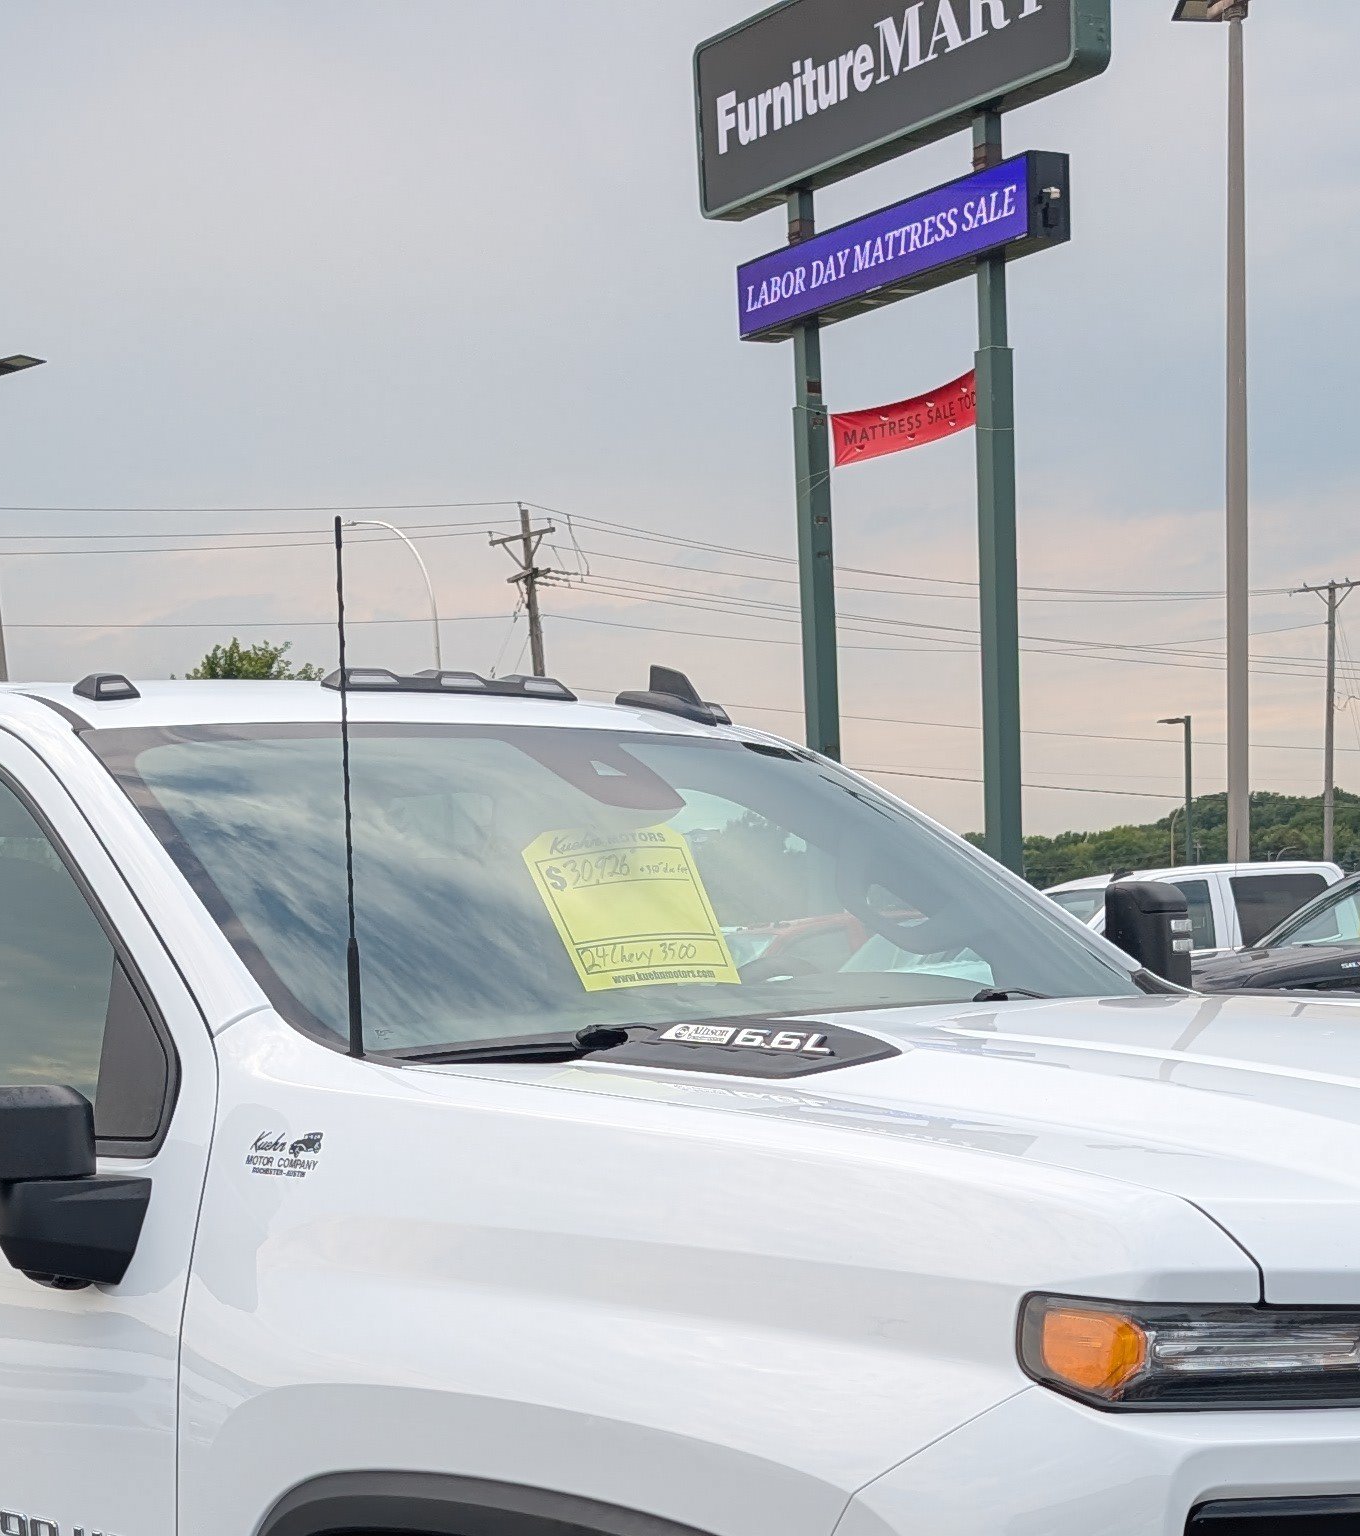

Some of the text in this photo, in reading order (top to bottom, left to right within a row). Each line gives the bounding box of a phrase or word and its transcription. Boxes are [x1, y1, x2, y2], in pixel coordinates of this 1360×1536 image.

[746, 184, 1017, 313] LABOR DAY MATTRESS SALE
[843, 413, 922, 447] MATTRESS
[927, 404, 956, 426] SALE
[659, 942, 697, 962] 3500
[732, 1028, 836, 1057] 6.6L
[245, 1155, 319, 1171] MOTOR COMPANY
